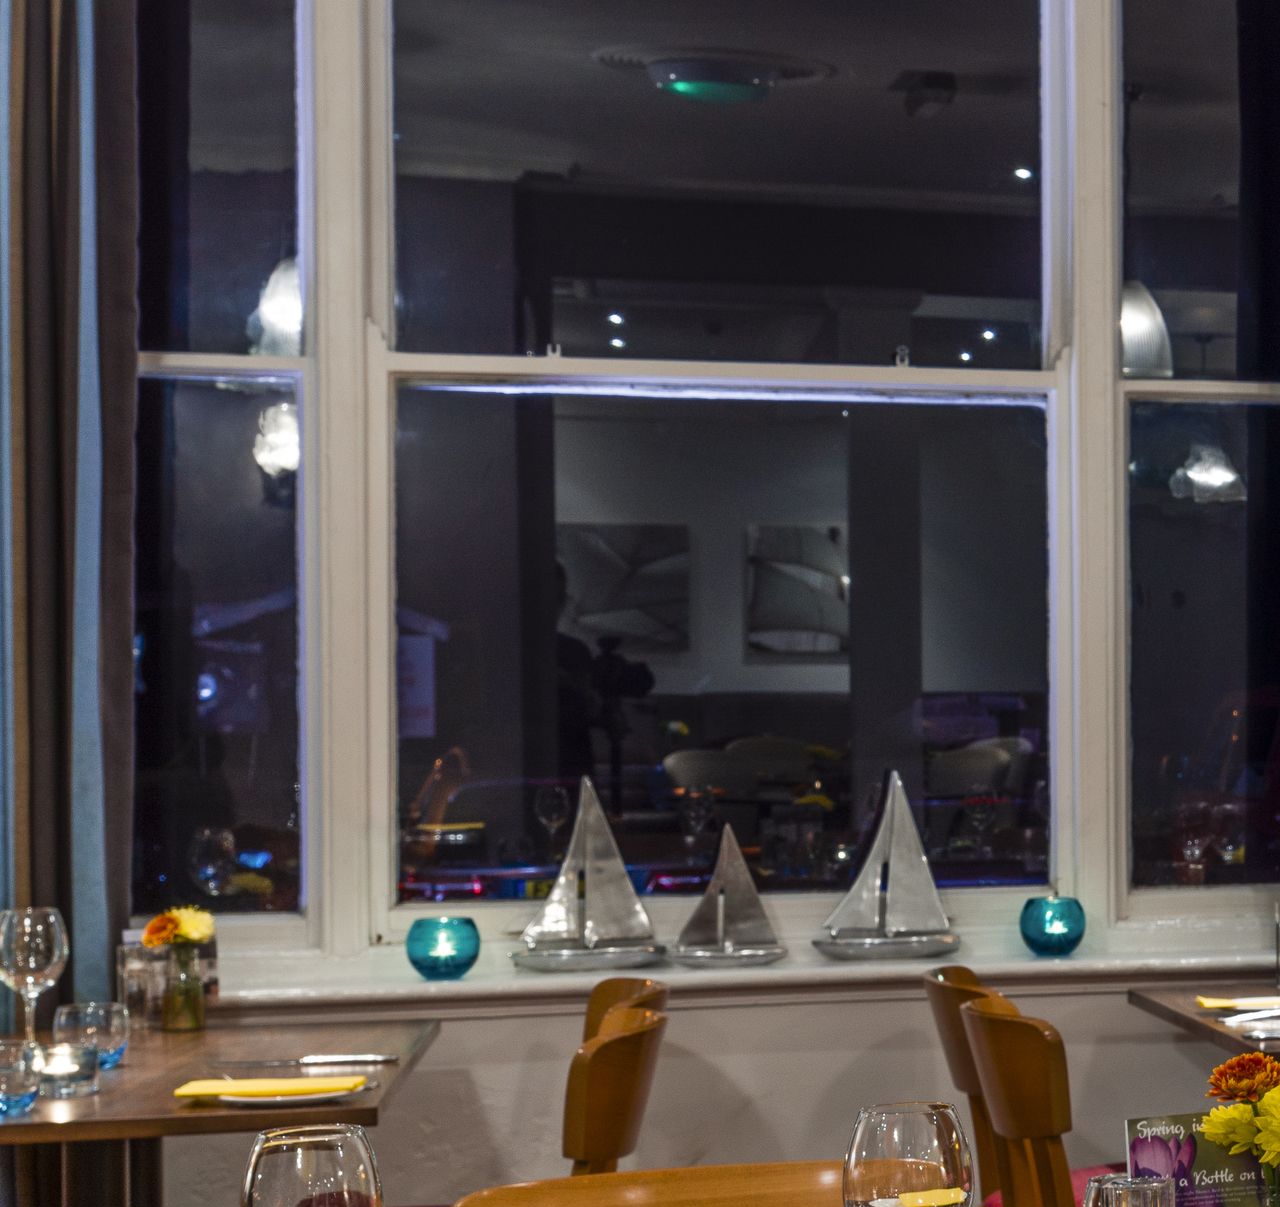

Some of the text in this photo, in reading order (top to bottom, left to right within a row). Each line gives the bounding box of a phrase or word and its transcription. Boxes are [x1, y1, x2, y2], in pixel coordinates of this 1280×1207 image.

[1136, 1120, 1185, 1143] Spring
[1179, 1177, 1189, 1188] a
[1193, 1168, 1234, 1186] Bottle
[1240, 1172, 1256, 1182] on
